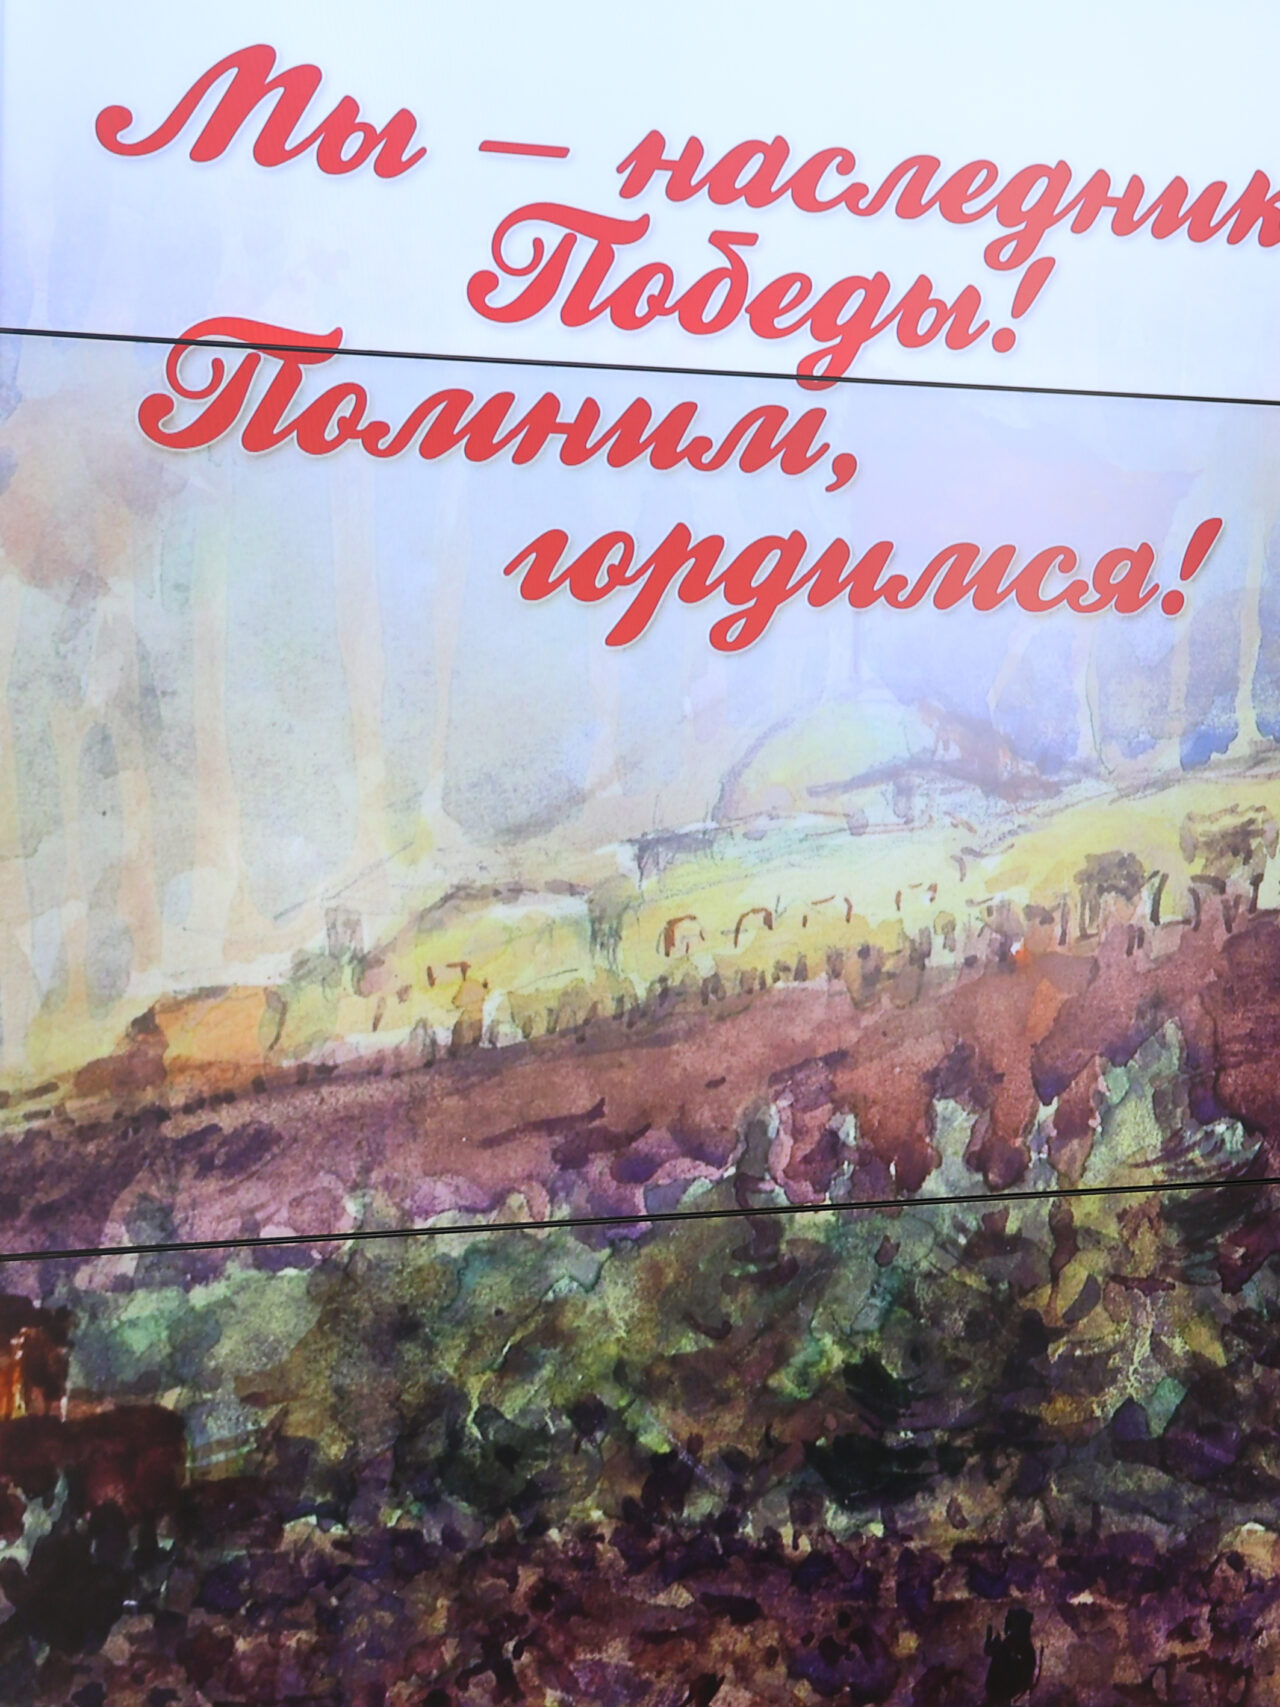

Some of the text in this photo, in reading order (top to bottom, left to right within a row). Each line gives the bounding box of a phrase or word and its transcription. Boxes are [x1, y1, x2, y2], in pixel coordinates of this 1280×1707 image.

[96, 44, 427, 179] Мы
[467, 202, 1056, 391] Победы!
[138, 316, 857, 493] Помним,
[504, 517, 1223, 653] гордимся!
